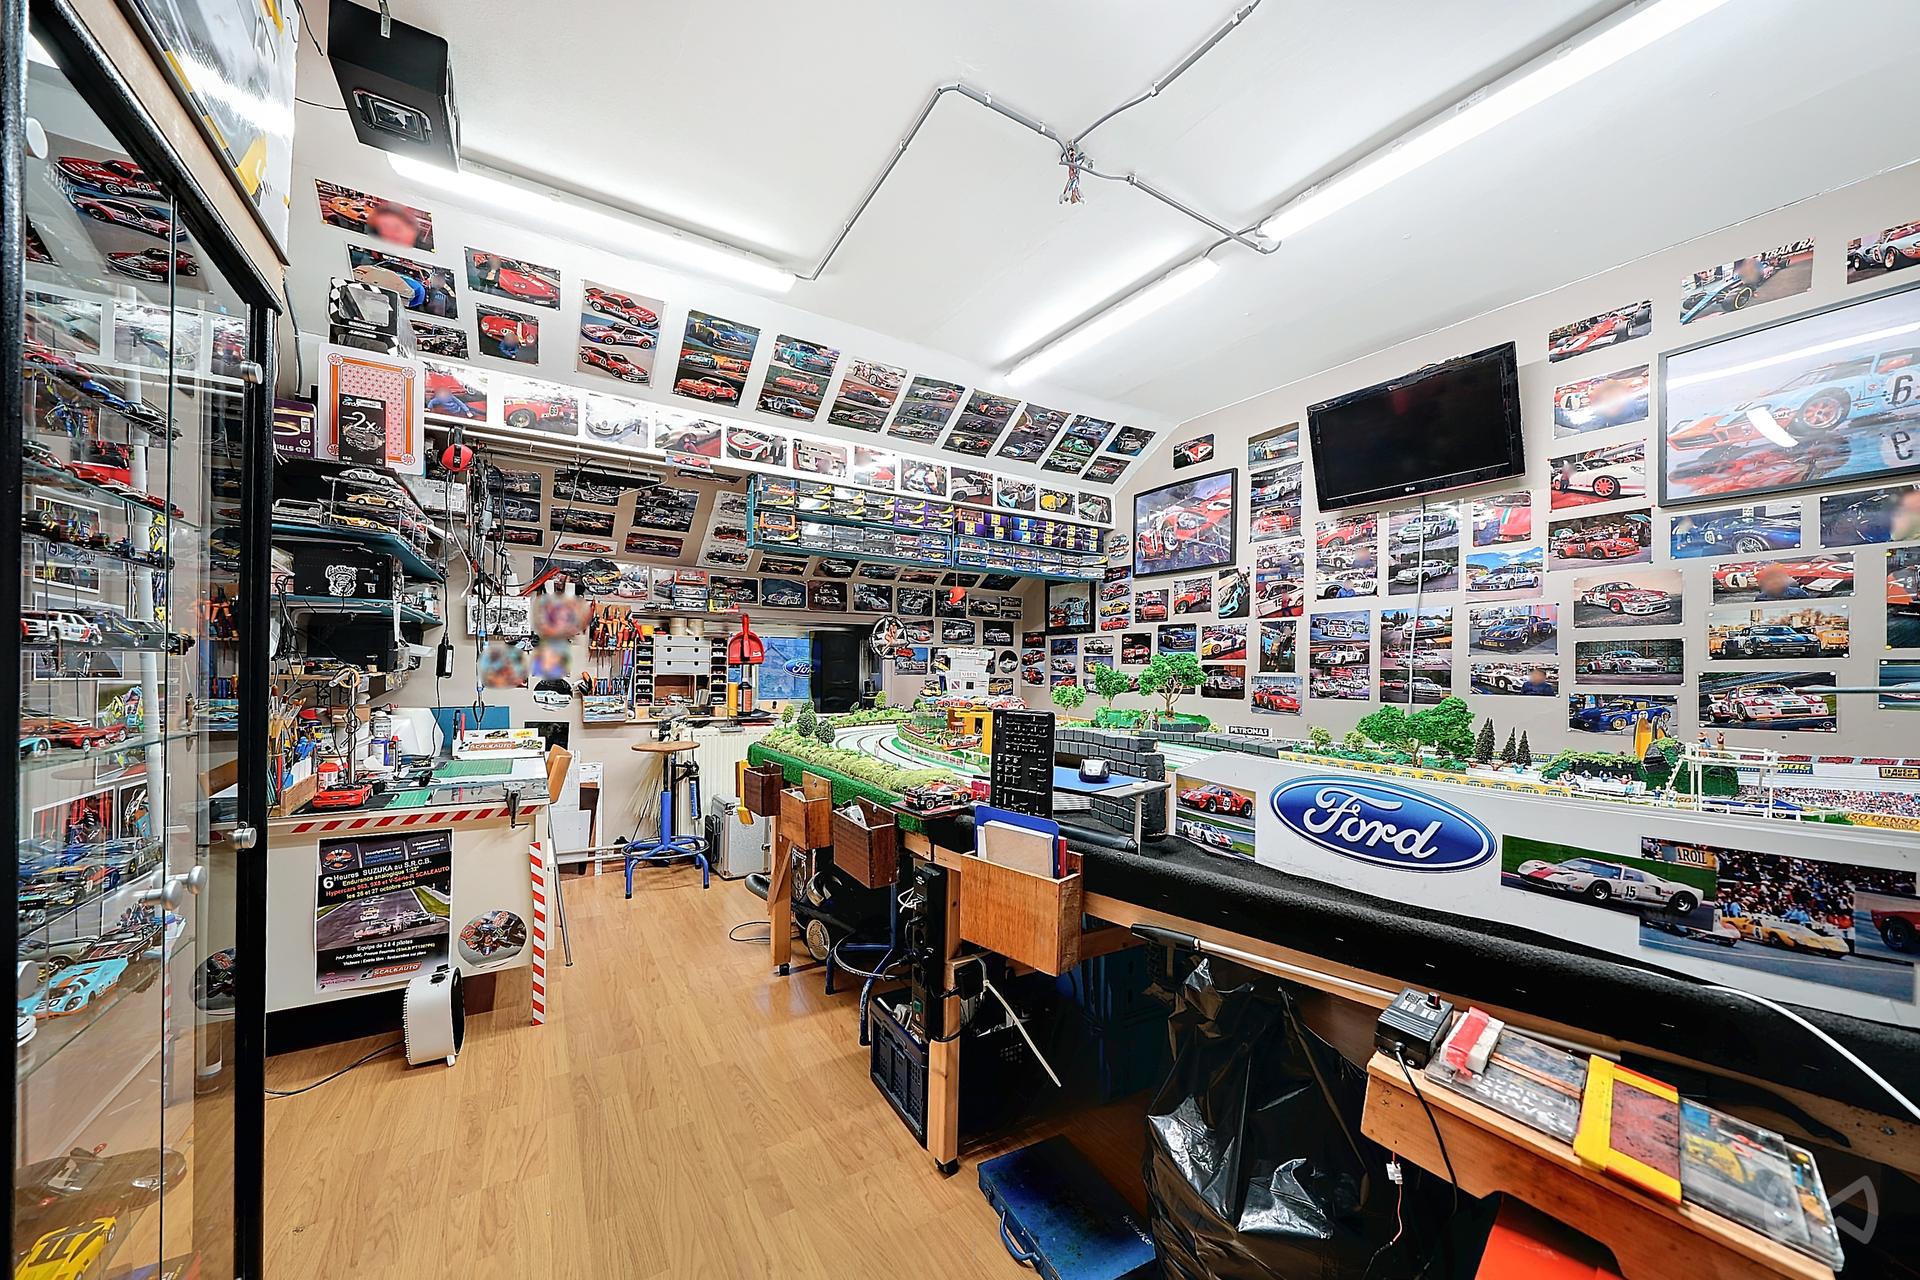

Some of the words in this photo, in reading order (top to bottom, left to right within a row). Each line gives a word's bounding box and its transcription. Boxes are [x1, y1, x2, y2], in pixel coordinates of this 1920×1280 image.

[1891, 374, 1914, 407] 6
[277, 443, 294, 451] STRI
[1230, 726, 1269, 736] PETRONAS
[1303, 786, 1443, 859] Ford
[323, 876, 334, 889] 6
[333, 871, 360, 882] Heures
[362, 865, 393, 876] SUZUKA
[404, 857, 432, 869] S.R.C.B.
[326, 886, 357, 897] Hypercars
[415, 866, 450, 878] SCALEAUTO
[342, 876, 374, 887] Endurance
[374, 870, 405, 882] analogique
[380, 884, 401, 893] octobre
[1624, 885, 1636, 898] 15
